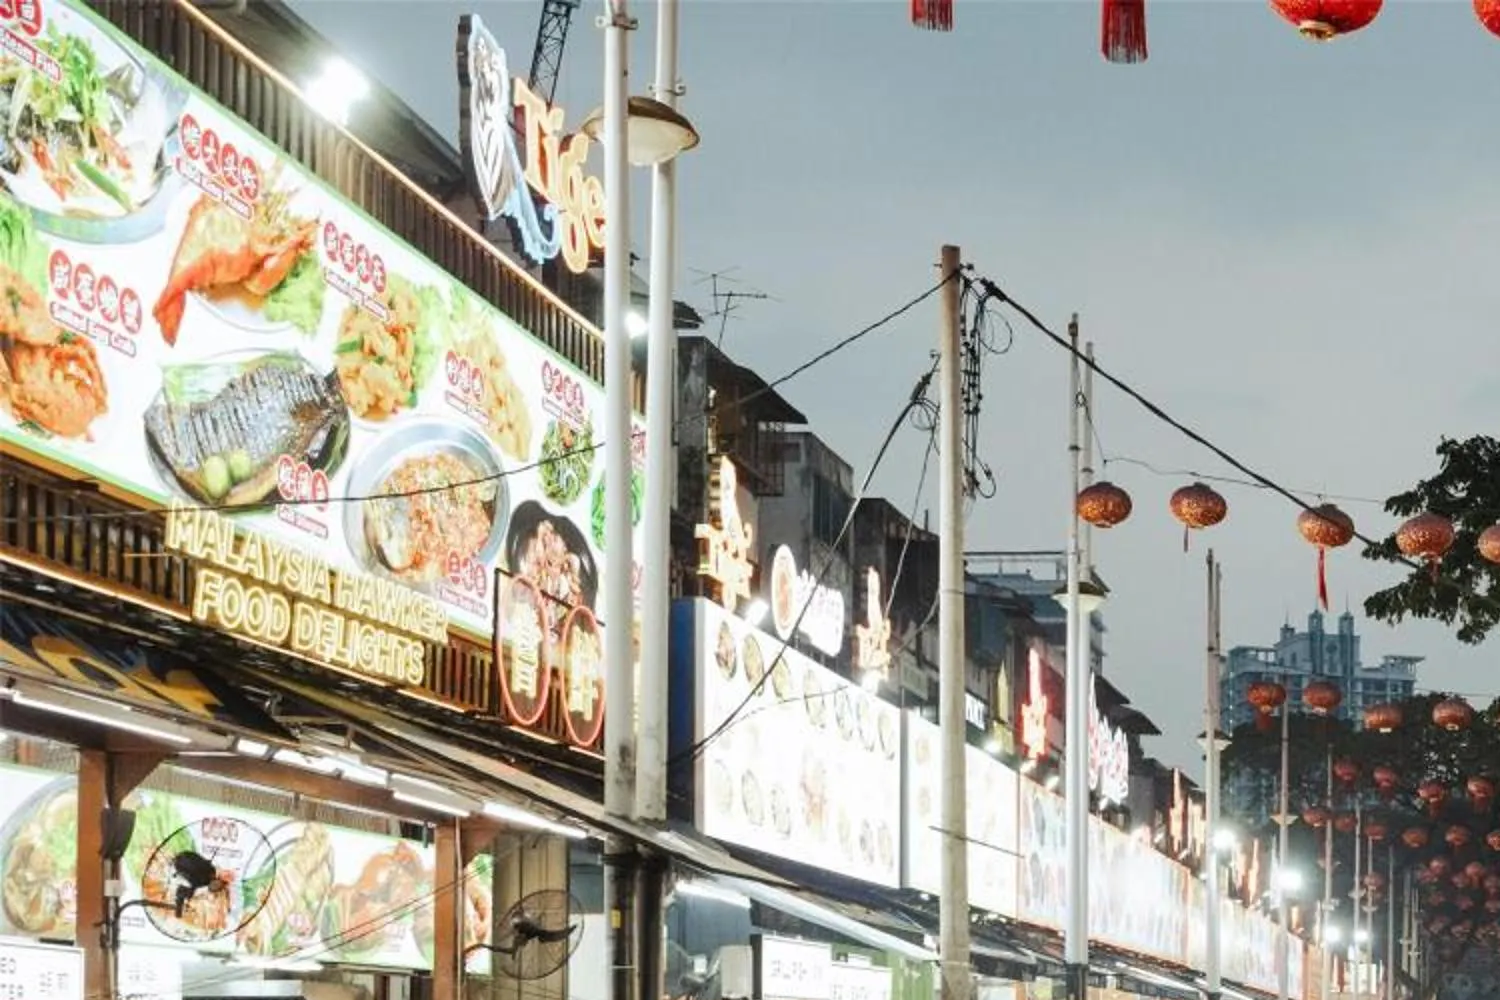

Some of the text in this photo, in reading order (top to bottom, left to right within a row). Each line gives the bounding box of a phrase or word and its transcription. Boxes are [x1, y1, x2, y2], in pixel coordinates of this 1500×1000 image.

[514, 77, 606, 274] Tige
[164, 498, 332, 606] MALAYSIA
[334, 566, 449, 646] HAWKER
[193, 568, 291, 642] FOOD
[291, 601, 426, 686] DELIGHTS
